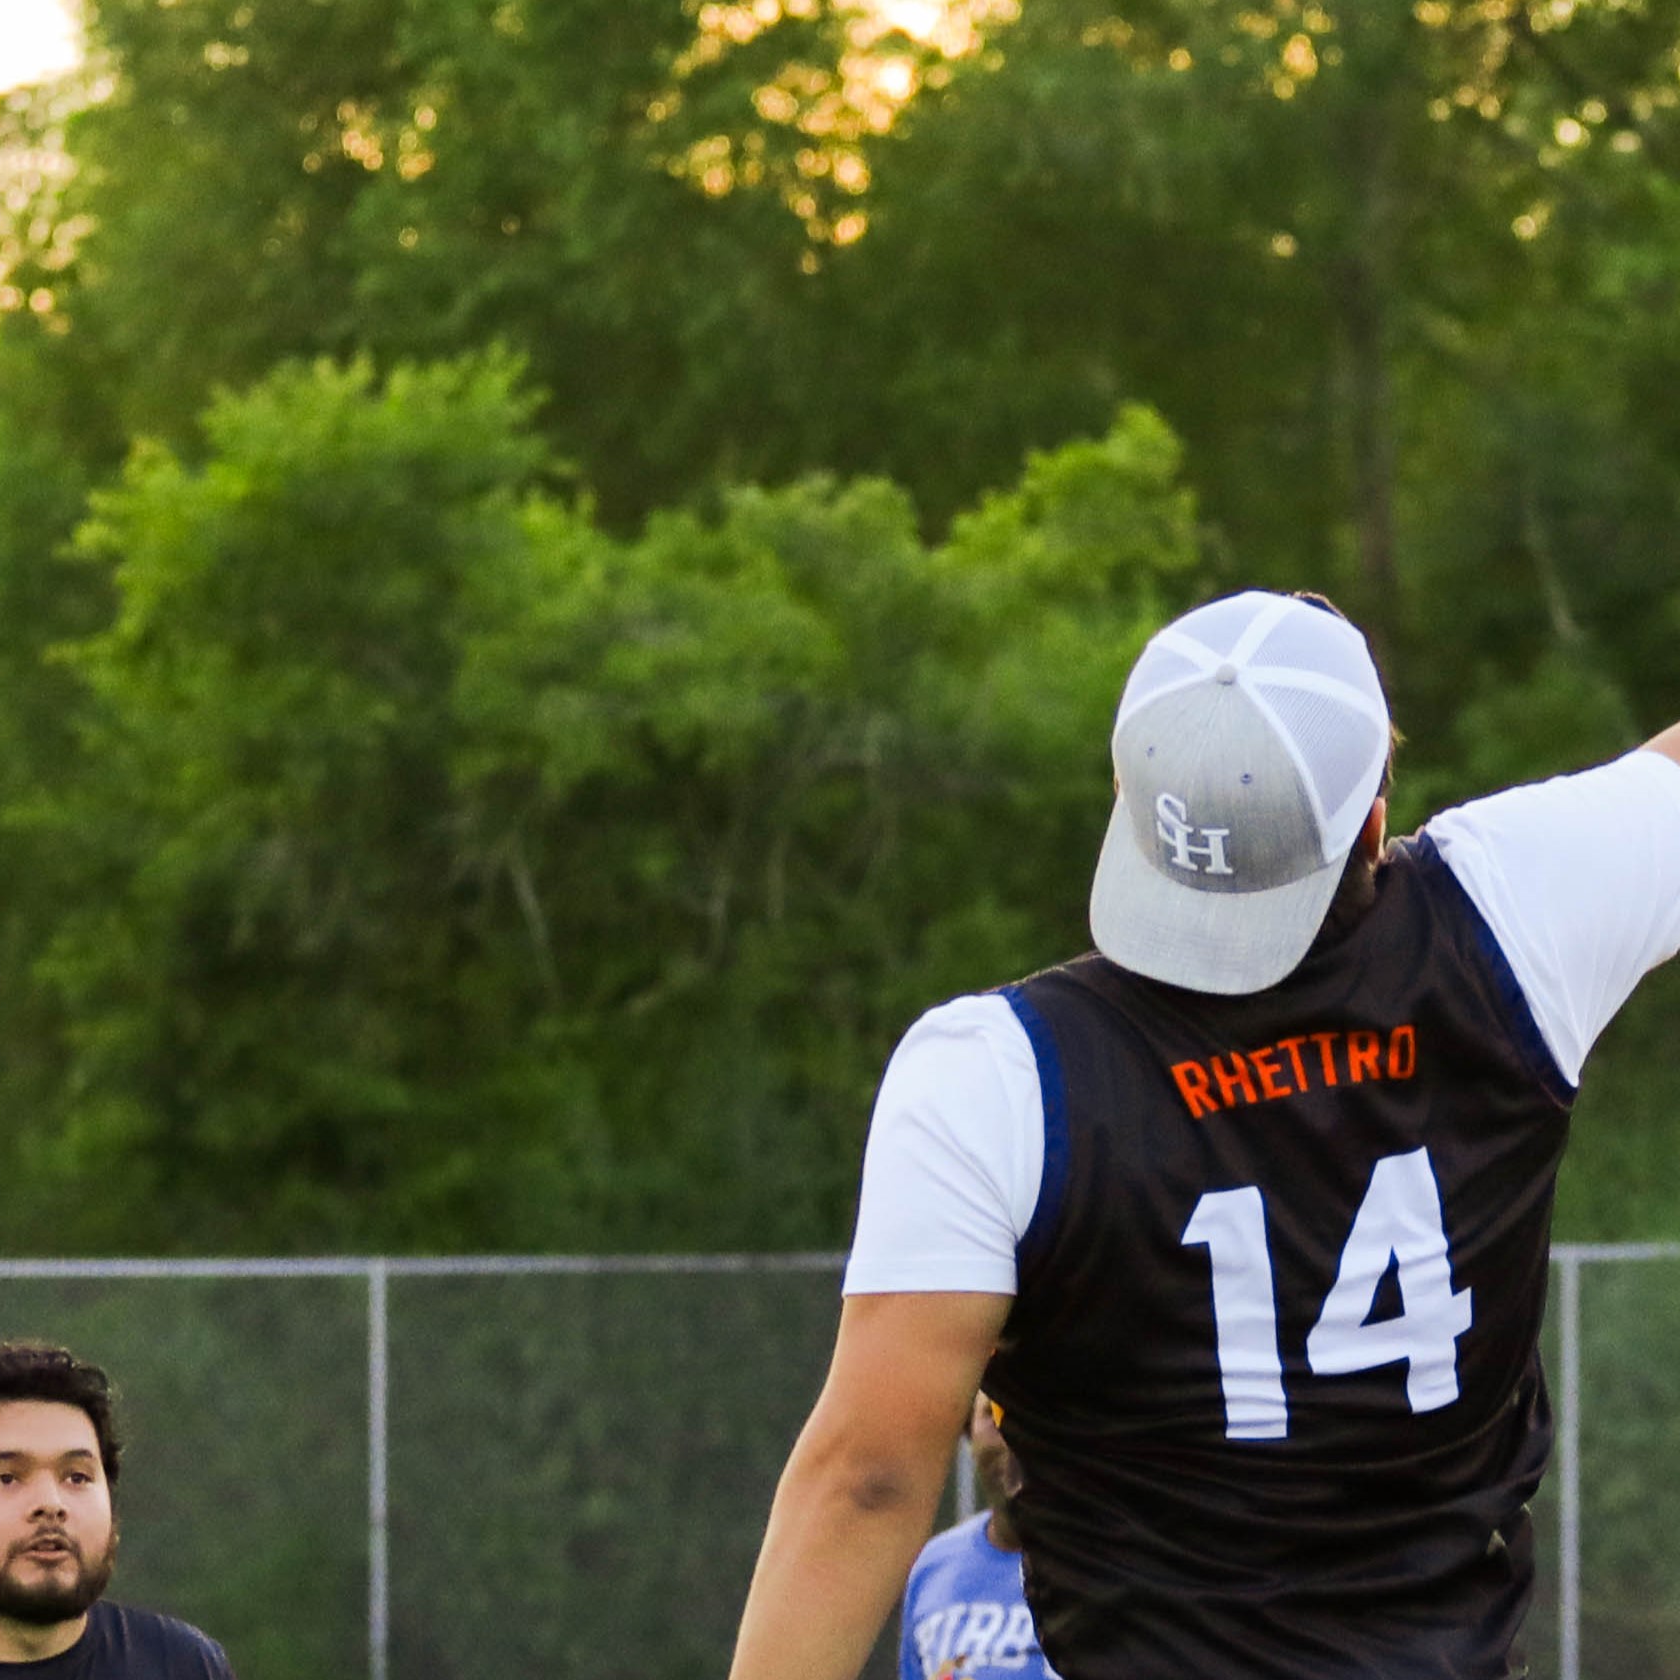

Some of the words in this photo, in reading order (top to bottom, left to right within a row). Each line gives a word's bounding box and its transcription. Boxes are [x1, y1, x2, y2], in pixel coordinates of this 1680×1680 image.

[1156, 792, 1234, 875] SH
[1170, 1023, 1417, 1120] RHETTRO
[1181, 1145, 1474, 1439] 14
